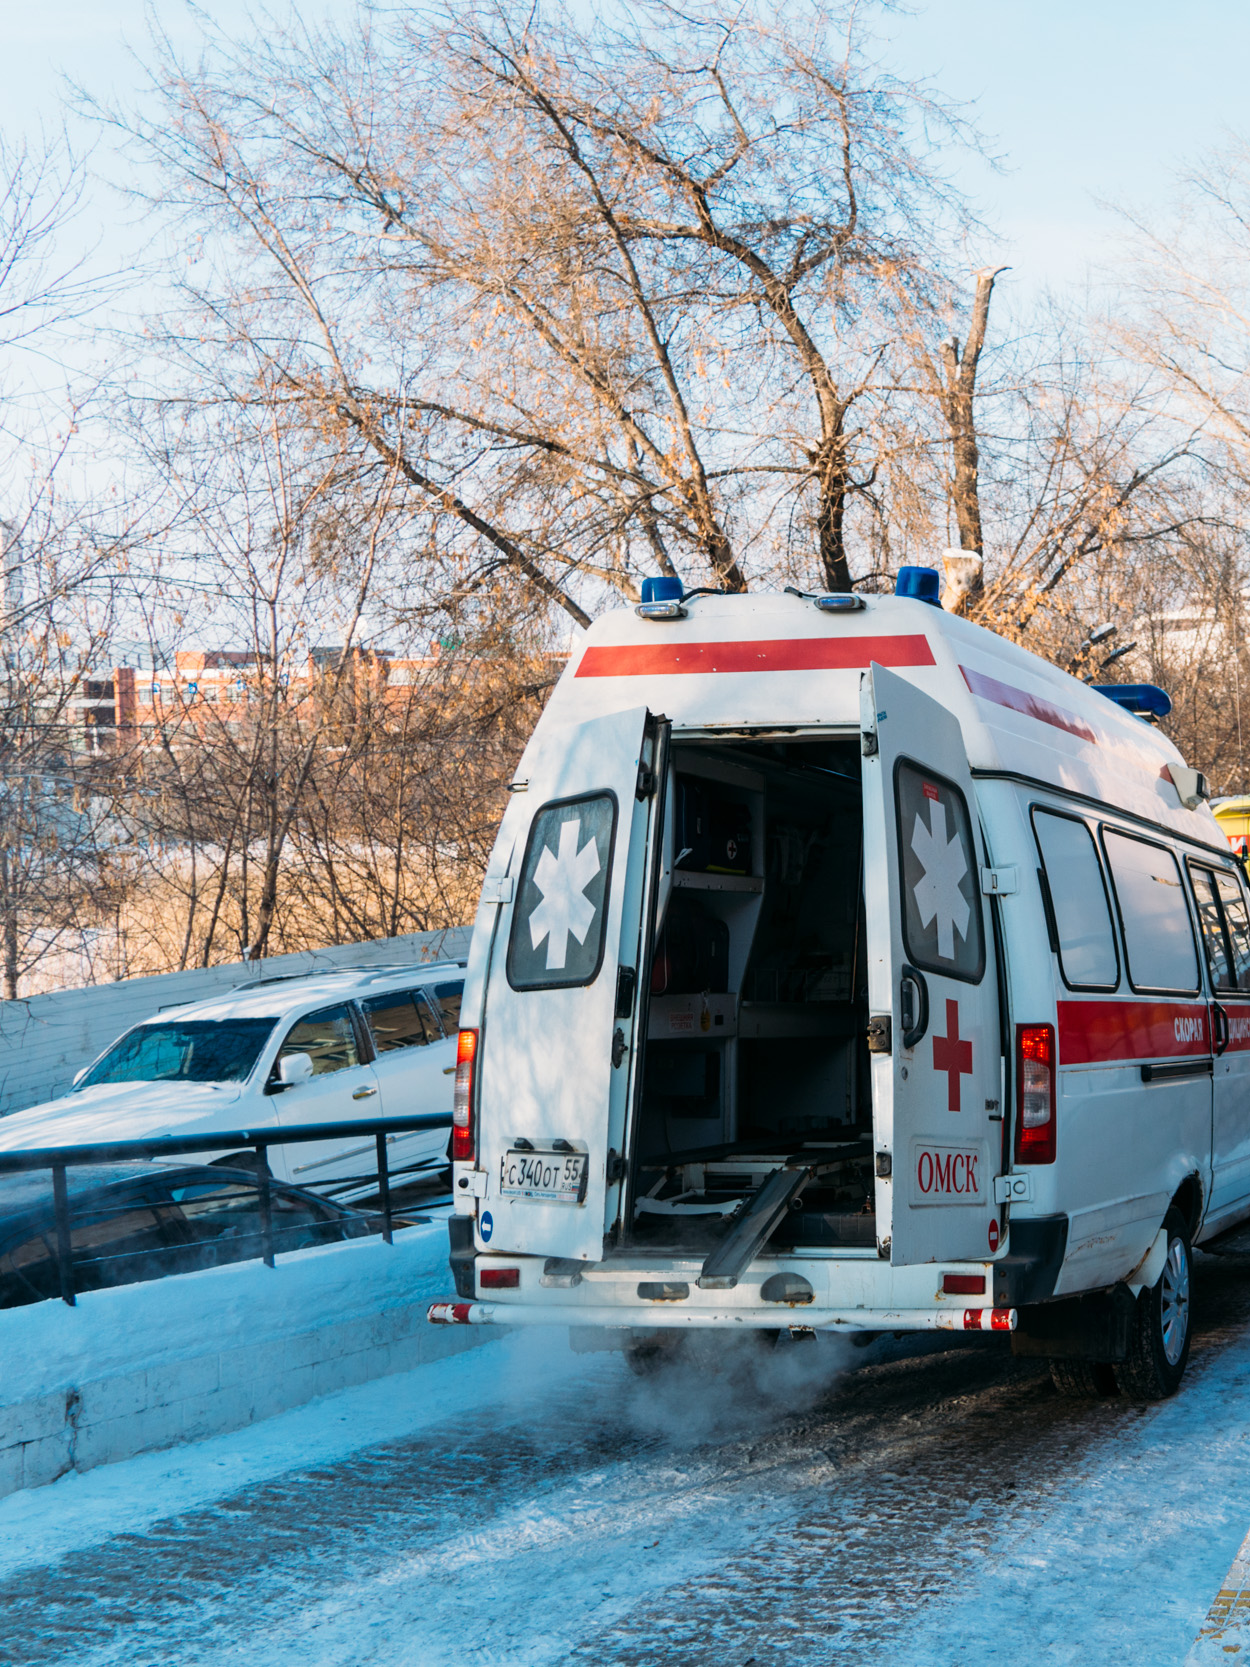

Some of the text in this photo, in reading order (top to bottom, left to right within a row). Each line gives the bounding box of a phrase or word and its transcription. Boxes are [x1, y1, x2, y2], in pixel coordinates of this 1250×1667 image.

[1174, 1017, 1204, 1042] СКОРАЯ
[564, 1159, 580, 1181] 55
[917, 1151, 979, 1193] ОМСК
